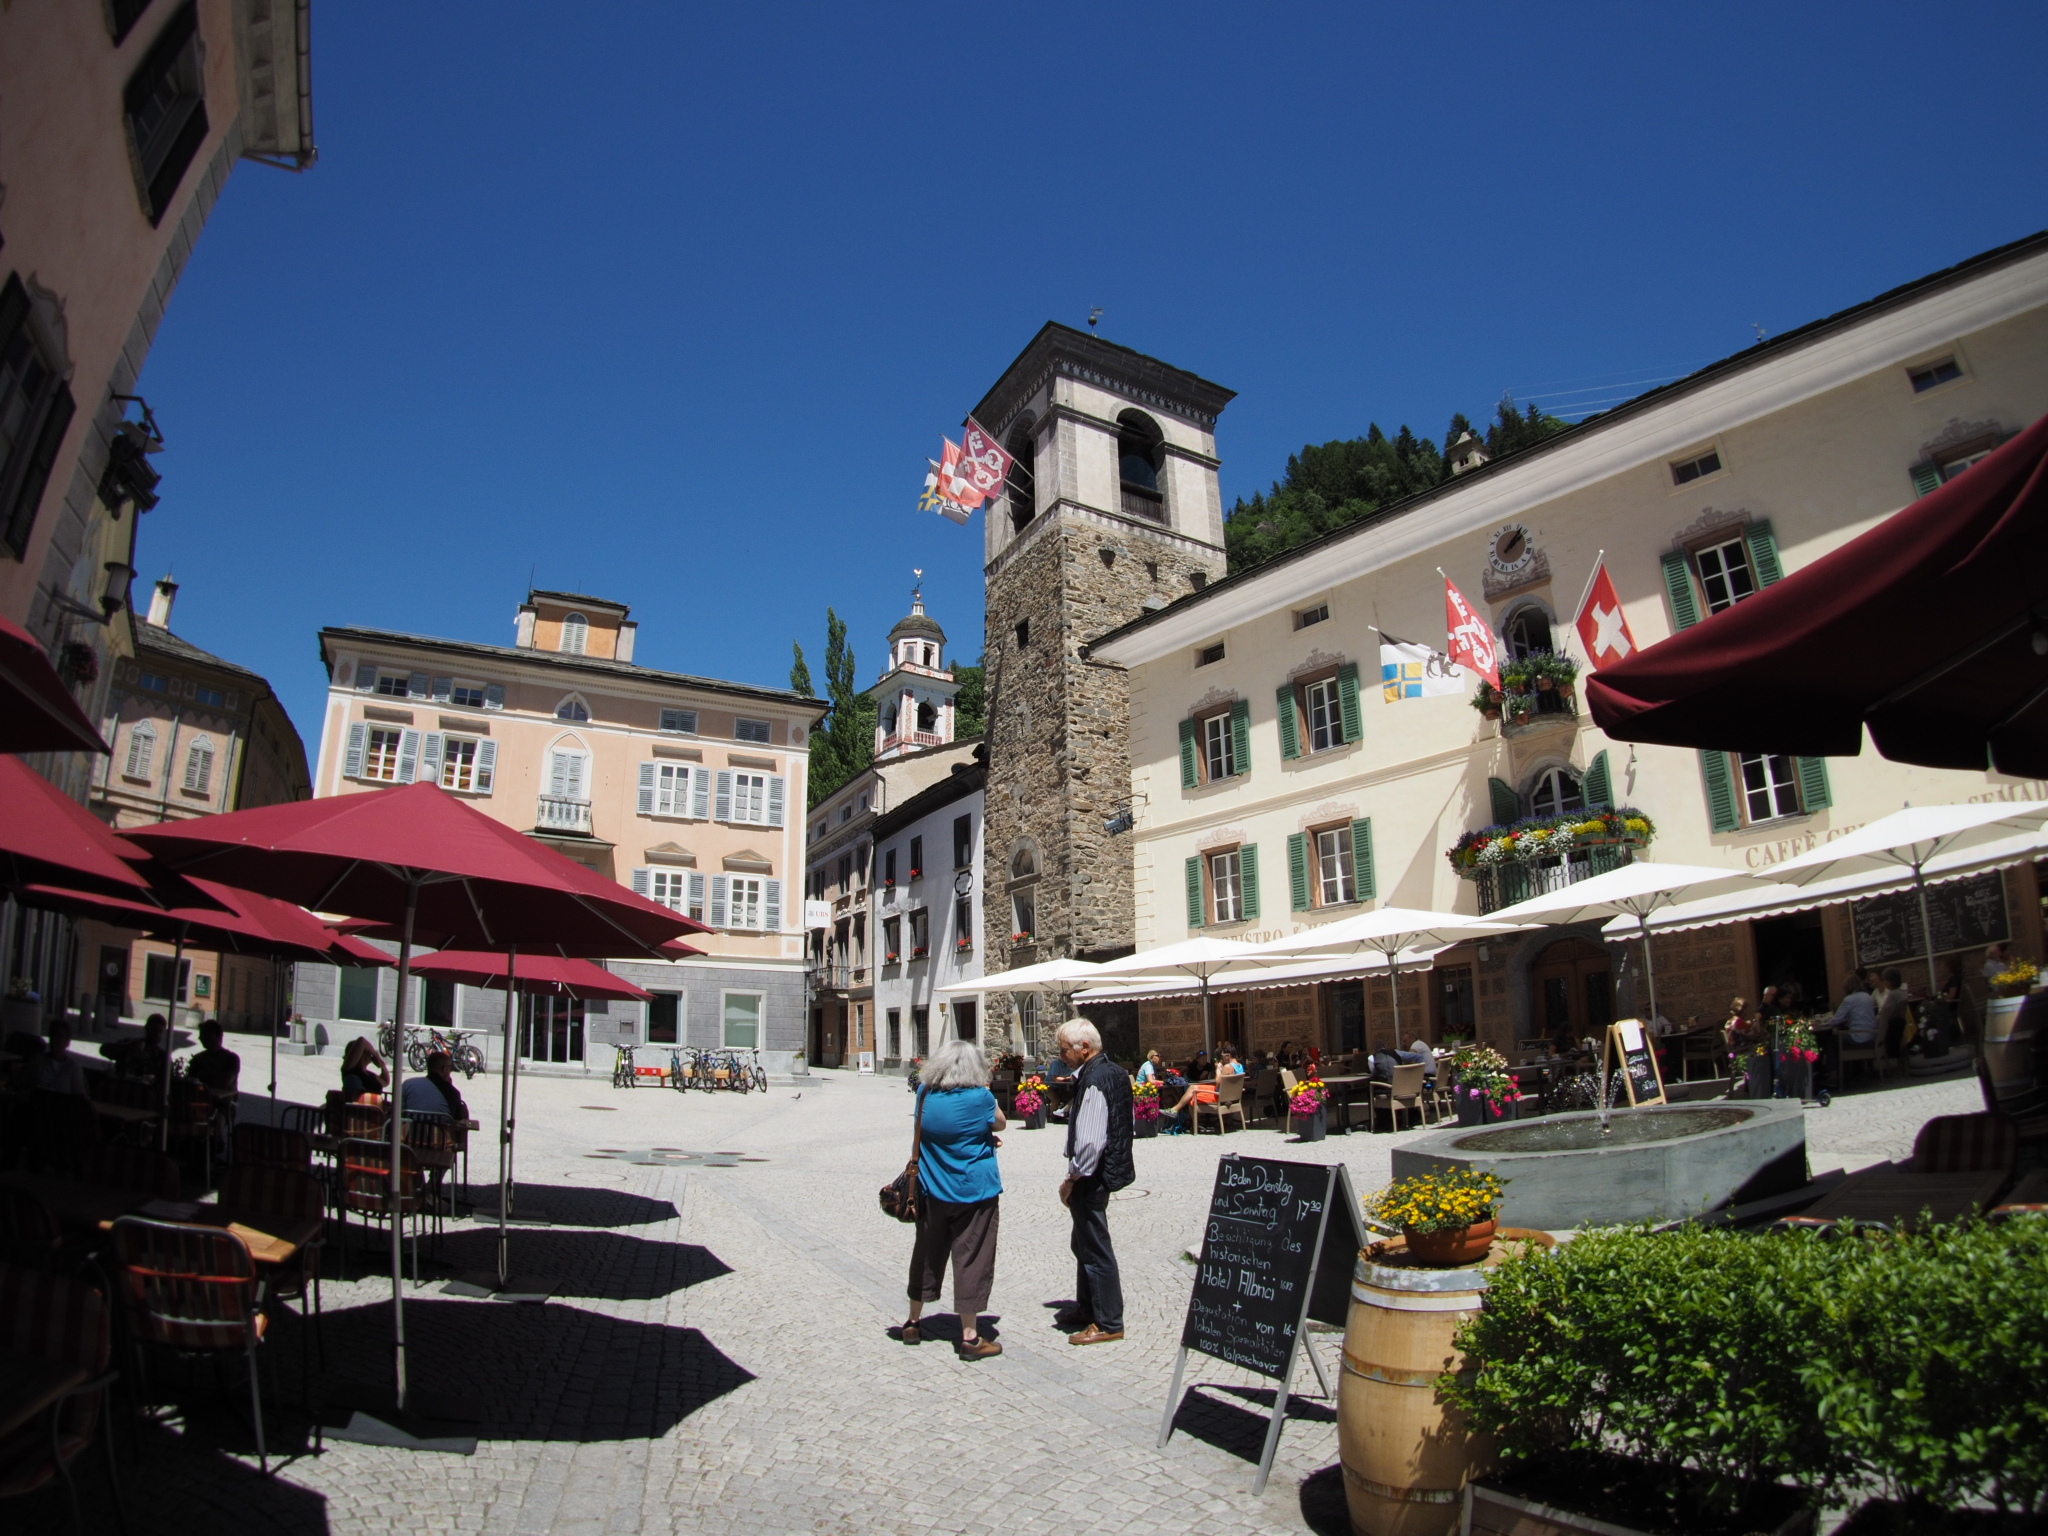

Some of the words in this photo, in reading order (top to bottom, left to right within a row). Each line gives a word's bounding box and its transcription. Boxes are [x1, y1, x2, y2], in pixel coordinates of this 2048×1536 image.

[1214, 1195, 1229, 1208] und
[1244, 1165, 1293, 1206] Dienstag
[1207, 1222, 1273, 1253] Besichtigung
[1281, 1228, 1301, 1253] des
[1210, 1244, 1271, 1270] historischen
[1202, 1263, 1231, 1290] Hotel
[1238, 1269, 1275, 1301] Albrici
[1191, 1298, 1247, 1326] Degustation
[1255, 1321, 1274, 1335] von
[1195, 1315, 1221, 1337] lokalen
[1200, 1338, 1219, 1353] 100%
[1223, 1346, 1280, 1372] Valposchiavo
